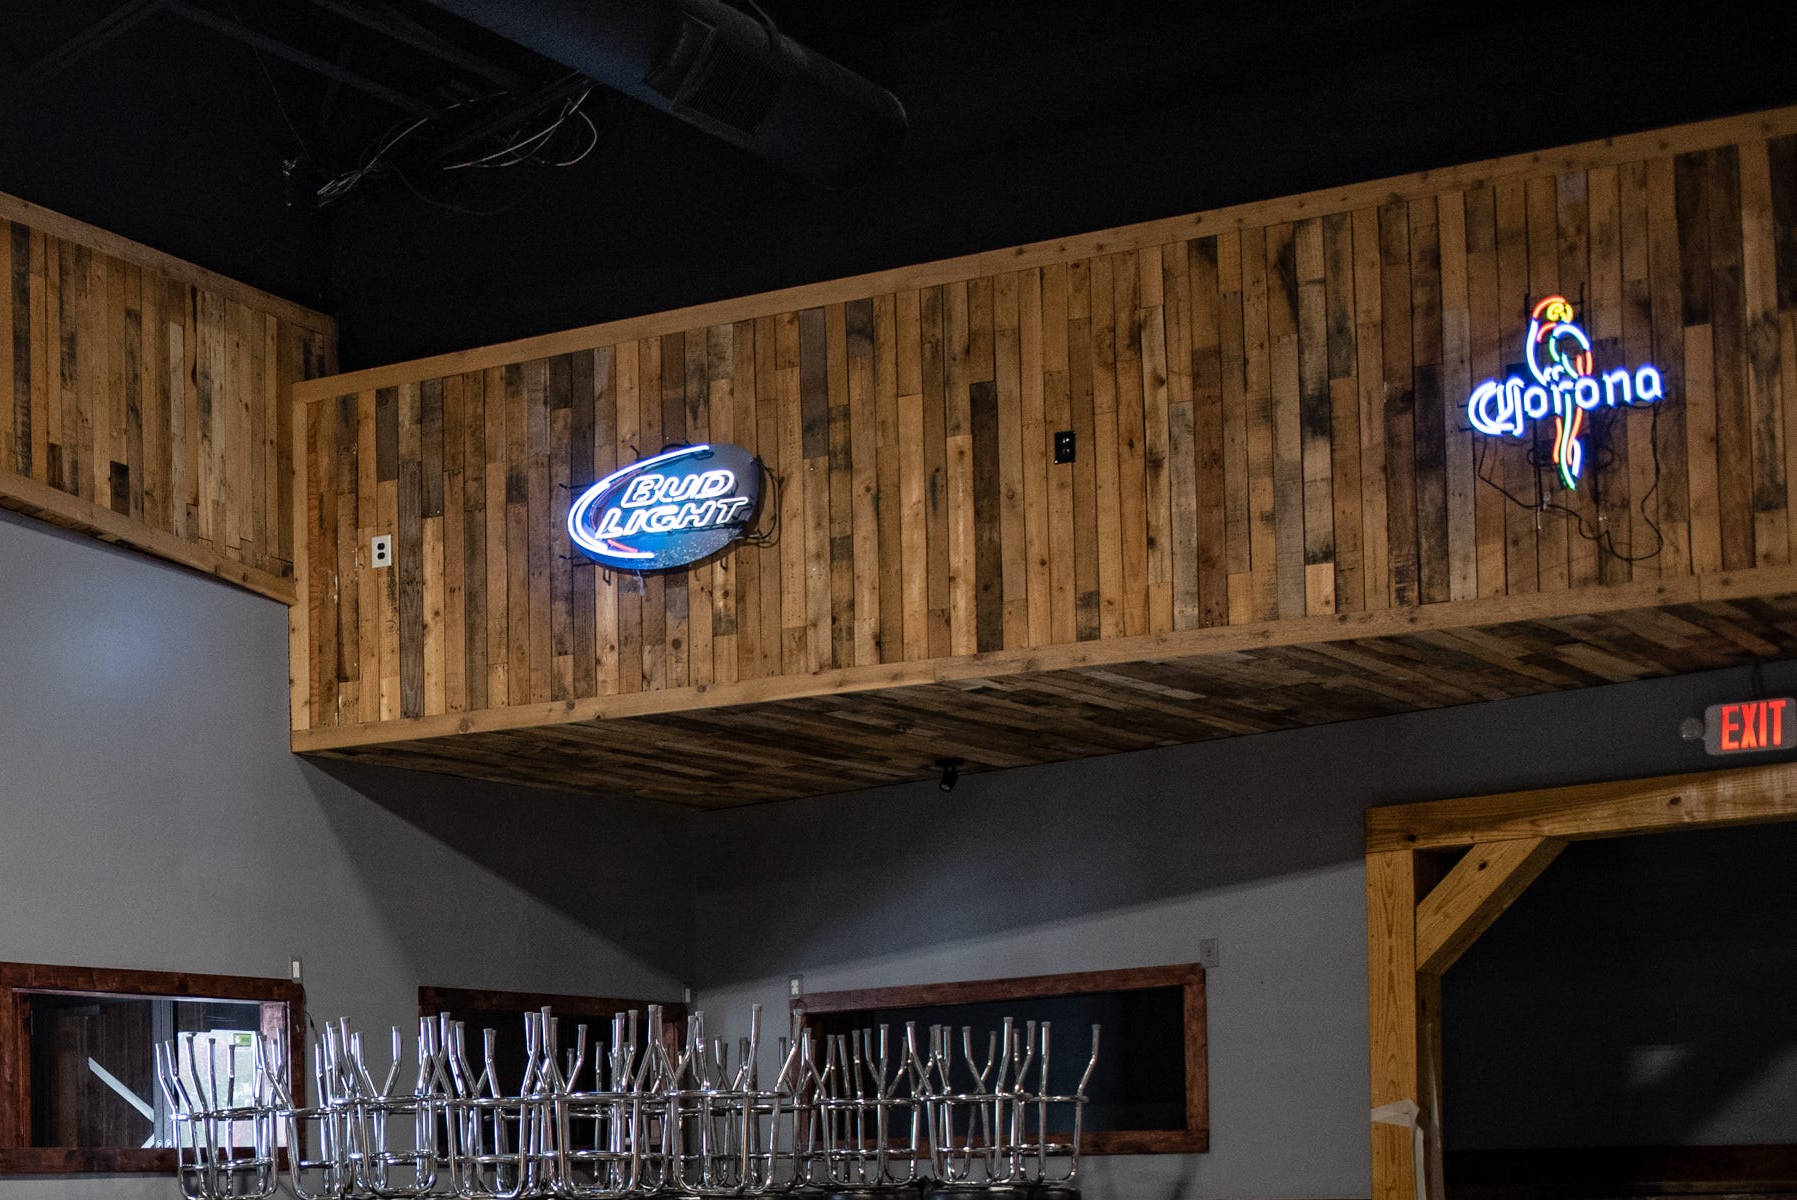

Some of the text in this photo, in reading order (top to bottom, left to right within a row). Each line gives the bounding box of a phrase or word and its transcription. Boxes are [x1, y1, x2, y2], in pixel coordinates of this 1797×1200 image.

[1467, 363, 1665, 437] Corona
[621, 470, 736, 508] BUD
[595, 496, 749, 539] LIGHT
[1721, 699, 1786, 751] EXIT
